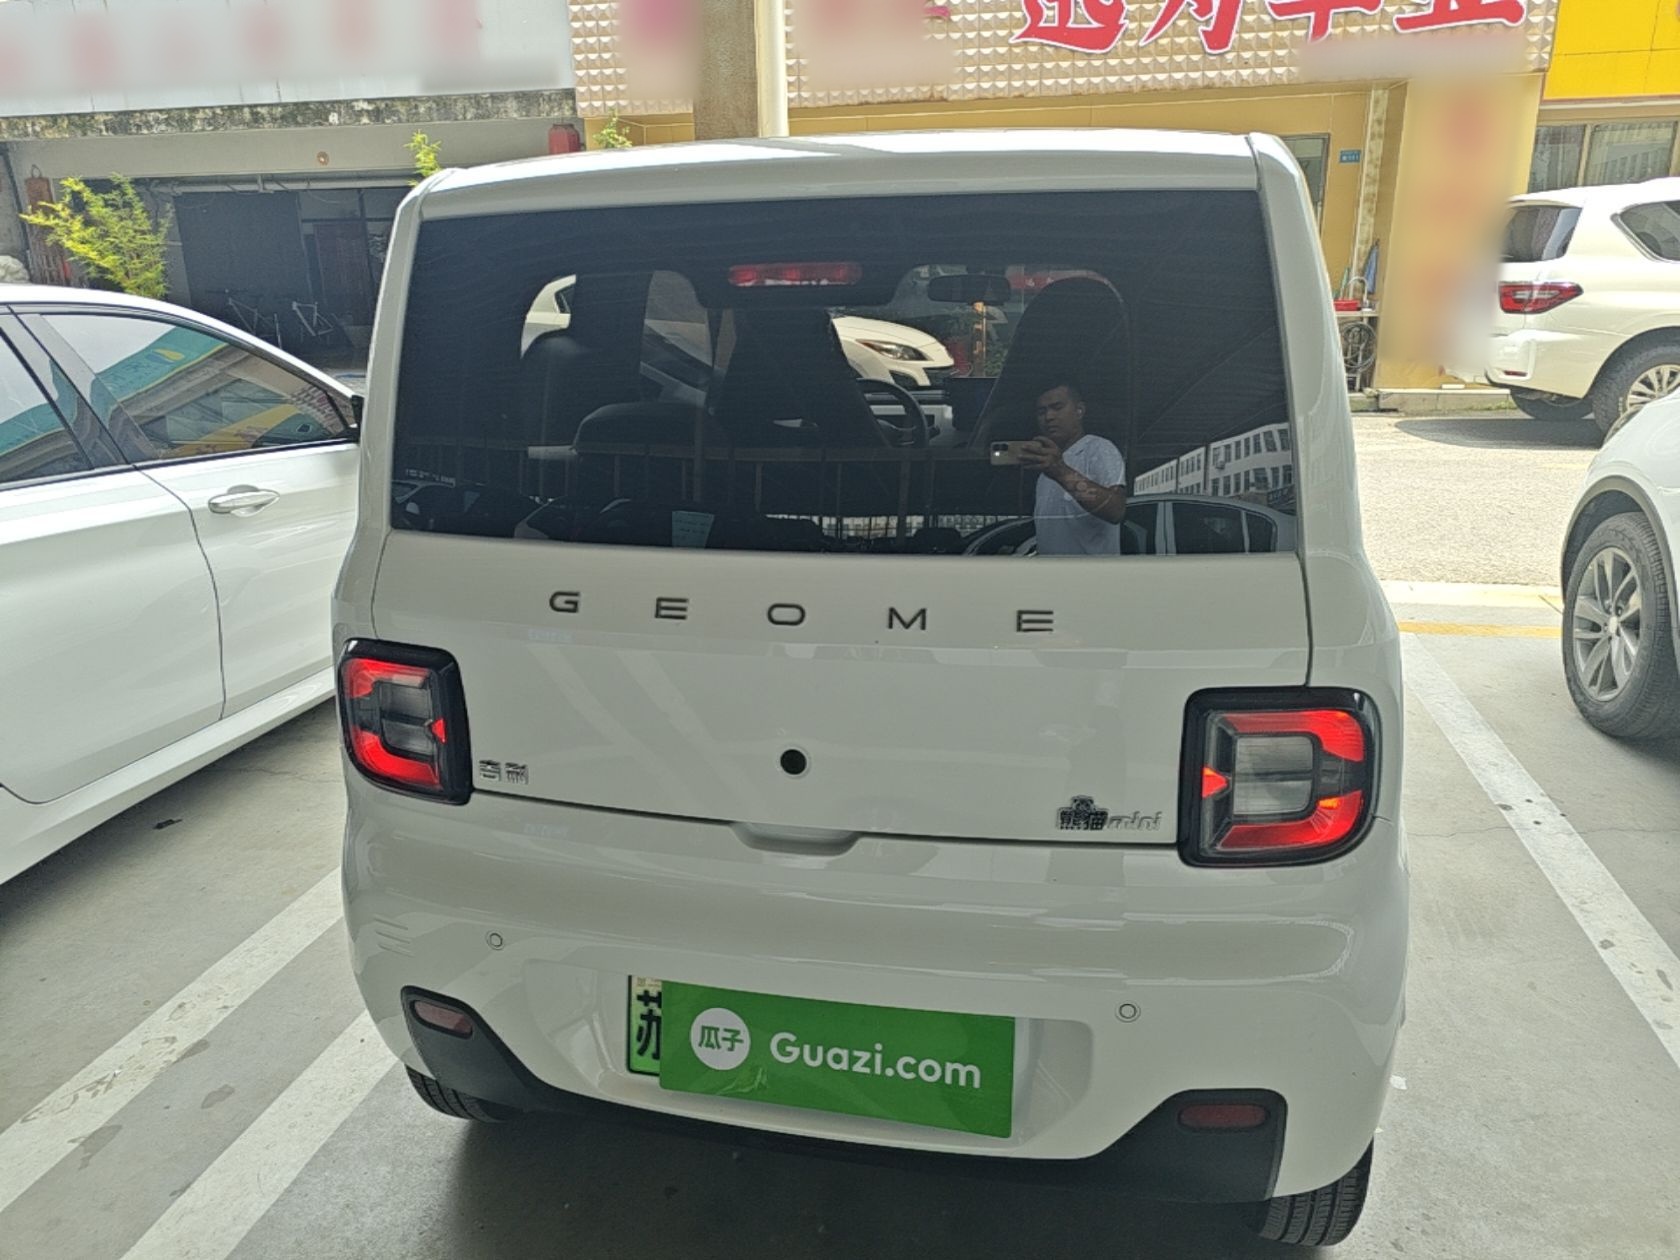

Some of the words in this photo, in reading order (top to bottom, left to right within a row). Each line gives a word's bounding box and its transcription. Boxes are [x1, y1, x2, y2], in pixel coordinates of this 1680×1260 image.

[549, 590, 1054, 633] GEOME
[698, 1025, 744, 1052] 瓜子
[769, 1031, 982, 1089] Guazi.com
